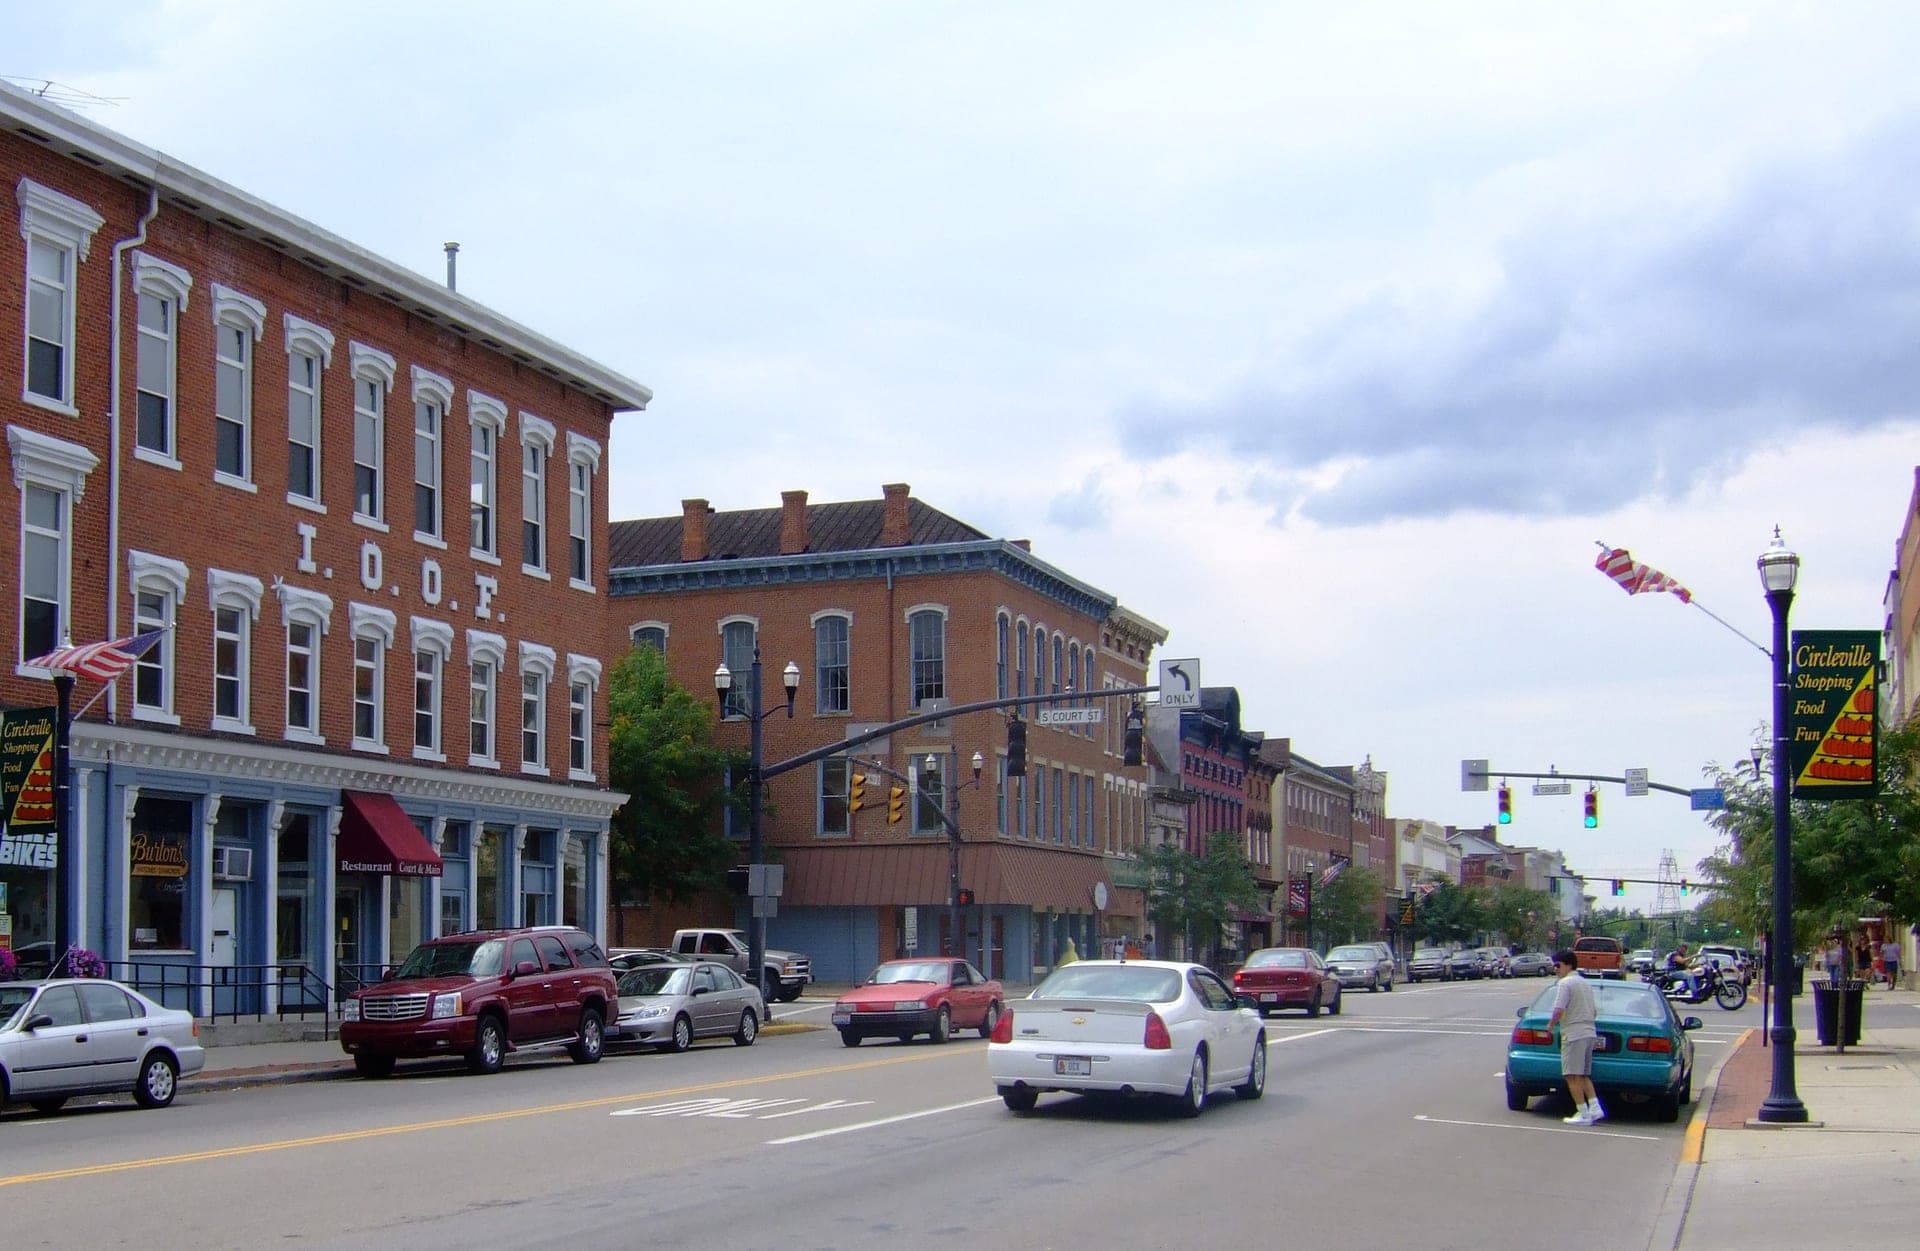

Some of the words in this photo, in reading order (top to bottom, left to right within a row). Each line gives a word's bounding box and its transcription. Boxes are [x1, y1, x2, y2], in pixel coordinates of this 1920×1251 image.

[1795, 644, 1872, 668] Circleville
[1795, 673, 1854, 692] Shopping
[1165, 694, 1195, 705] ONLY
[1794, 699, 1826, 715] Food
[1042, 712, 1049, 722] S
[1052, 711, 1084, 722] COURT
[1087, 710, 1100, 721] ST
[4, 719, 51, 738] Circleville
[1794, 726, 1821, 742] Fun
[3, 741, 40, 755] Shopping
[3, 761, 22, 773] Food
[4, 782, 20, 793] Fun
[0, 842, 57, 869] BIKES
[341, 860, 392, 872] Restaurant
[399, 862, 417, 873] Court
